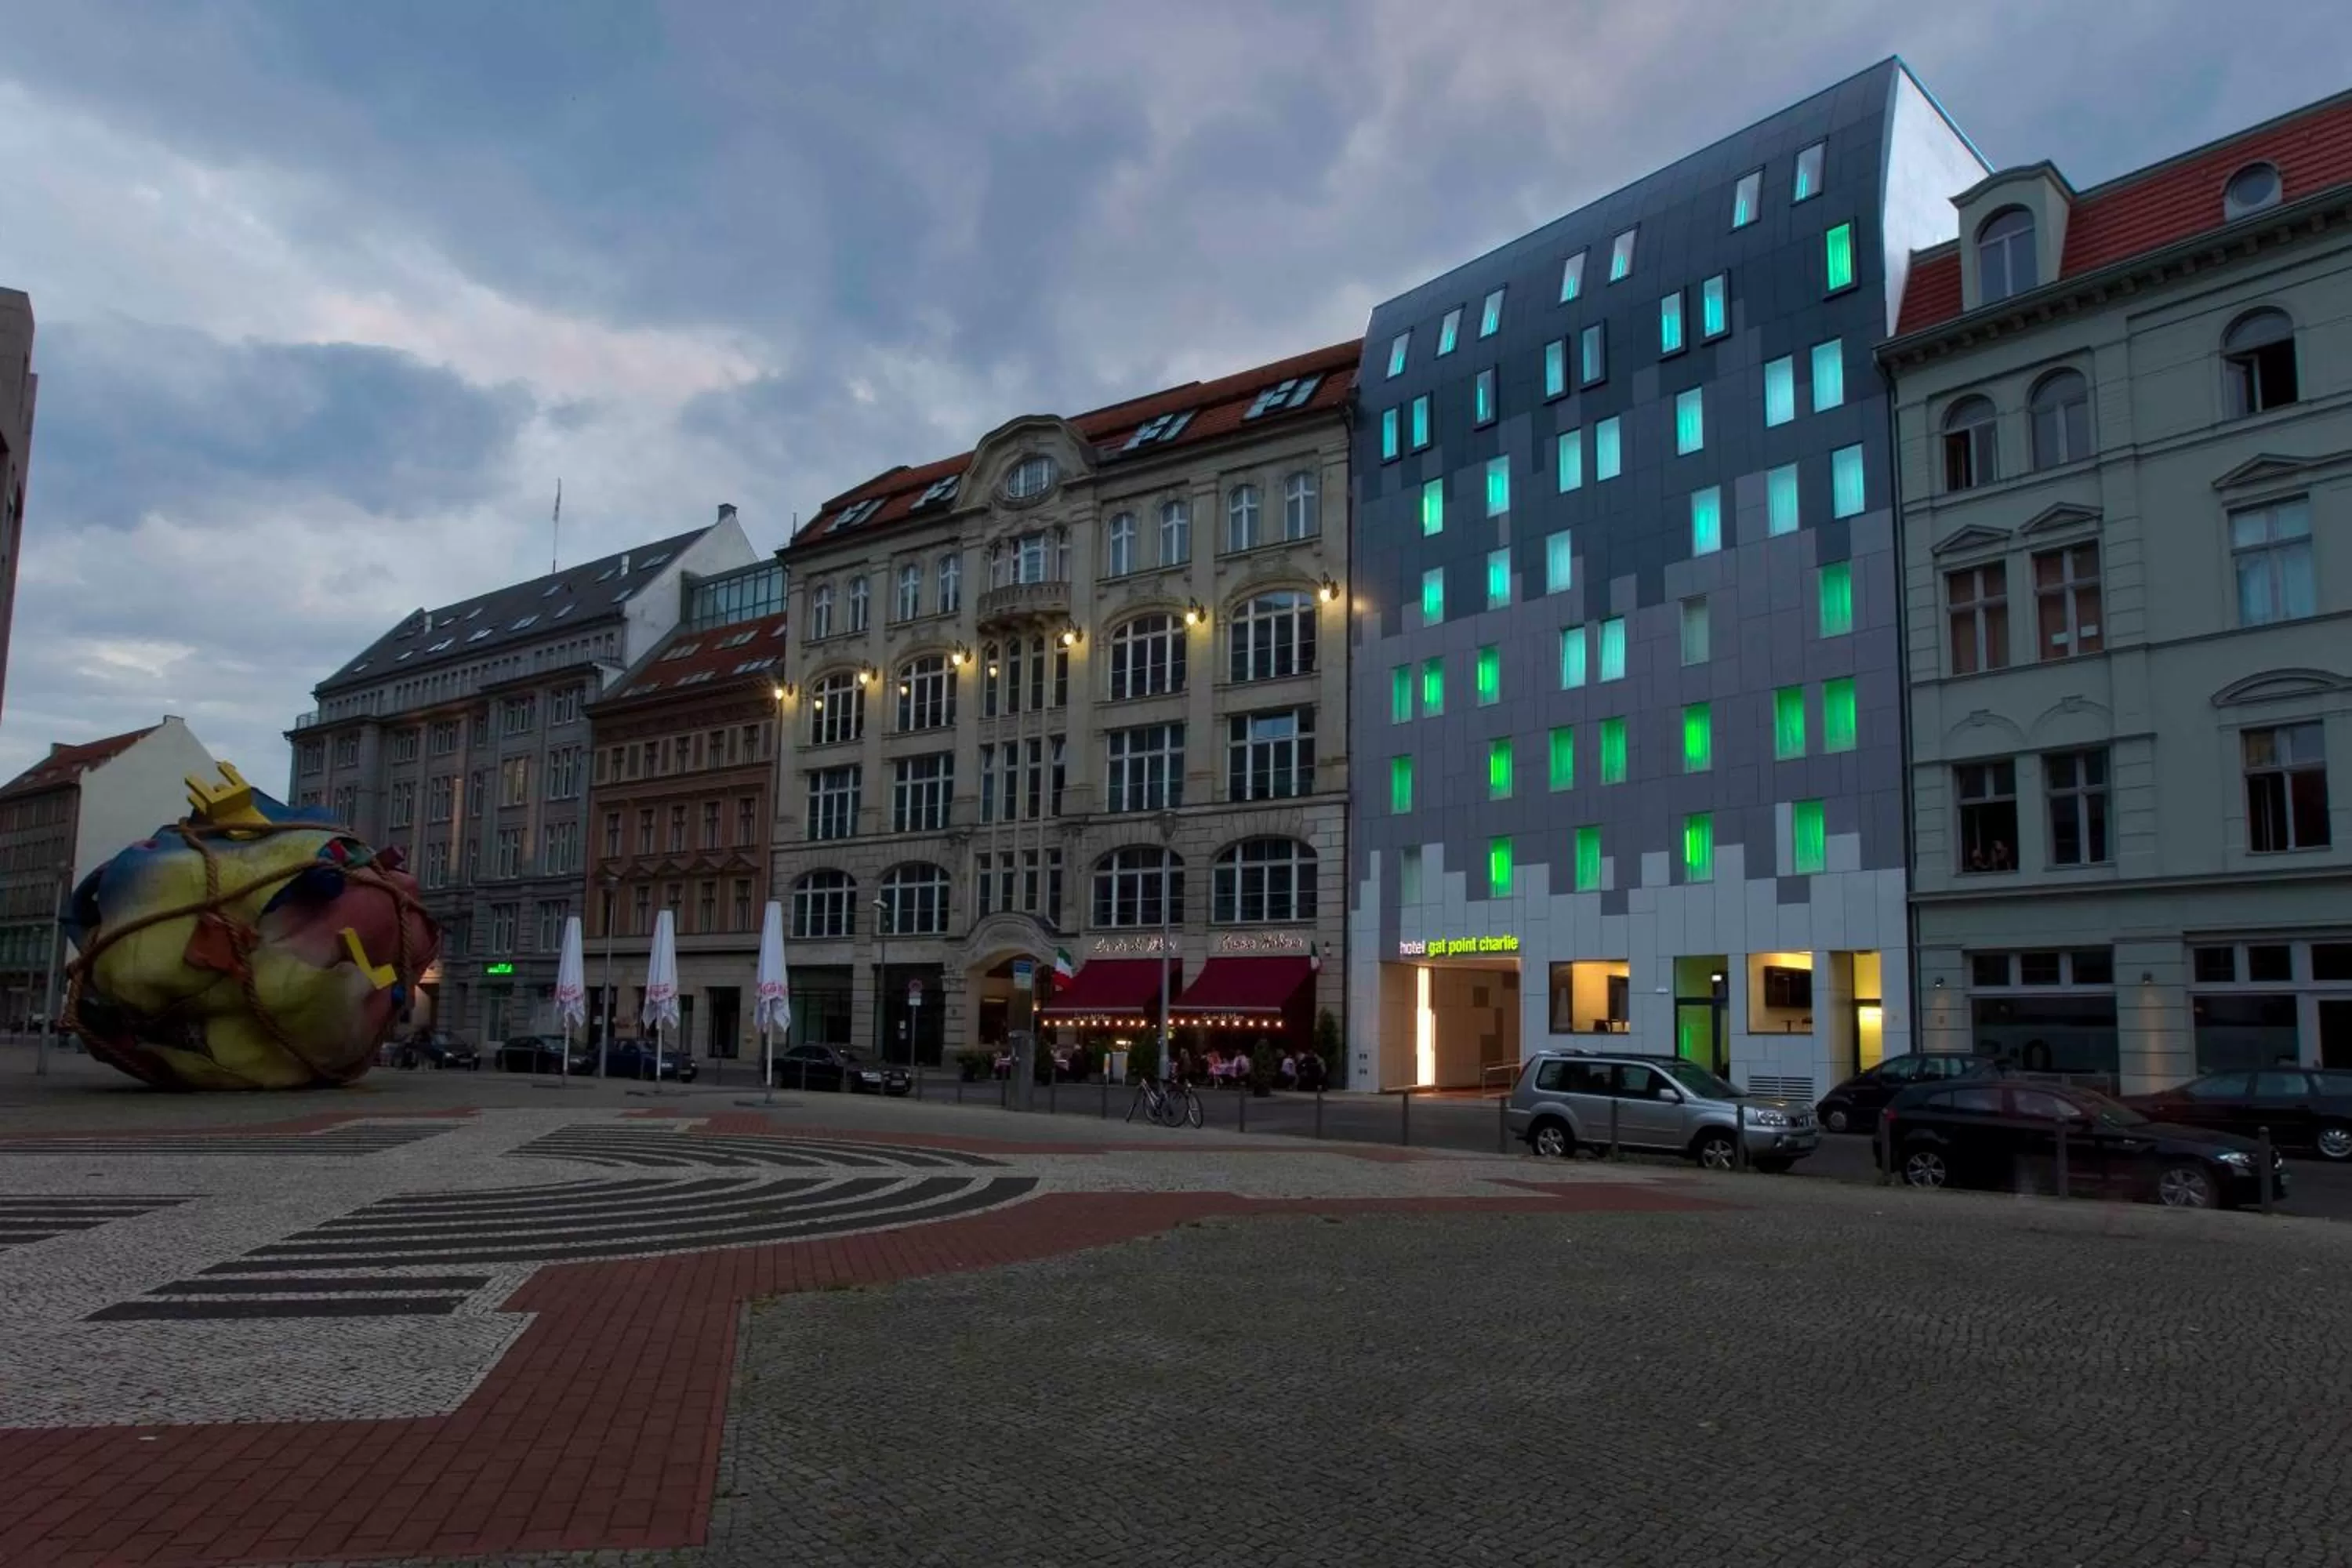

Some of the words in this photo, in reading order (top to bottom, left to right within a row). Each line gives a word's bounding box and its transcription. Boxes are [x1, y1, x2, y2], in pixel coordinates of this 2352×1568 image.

[1400, 940, 1426, 954] hotel
[1428, 939, 1446, 957] gat
[1448, 937, 1477, 956] point
[1479, 935, 1519, 951] charlie
